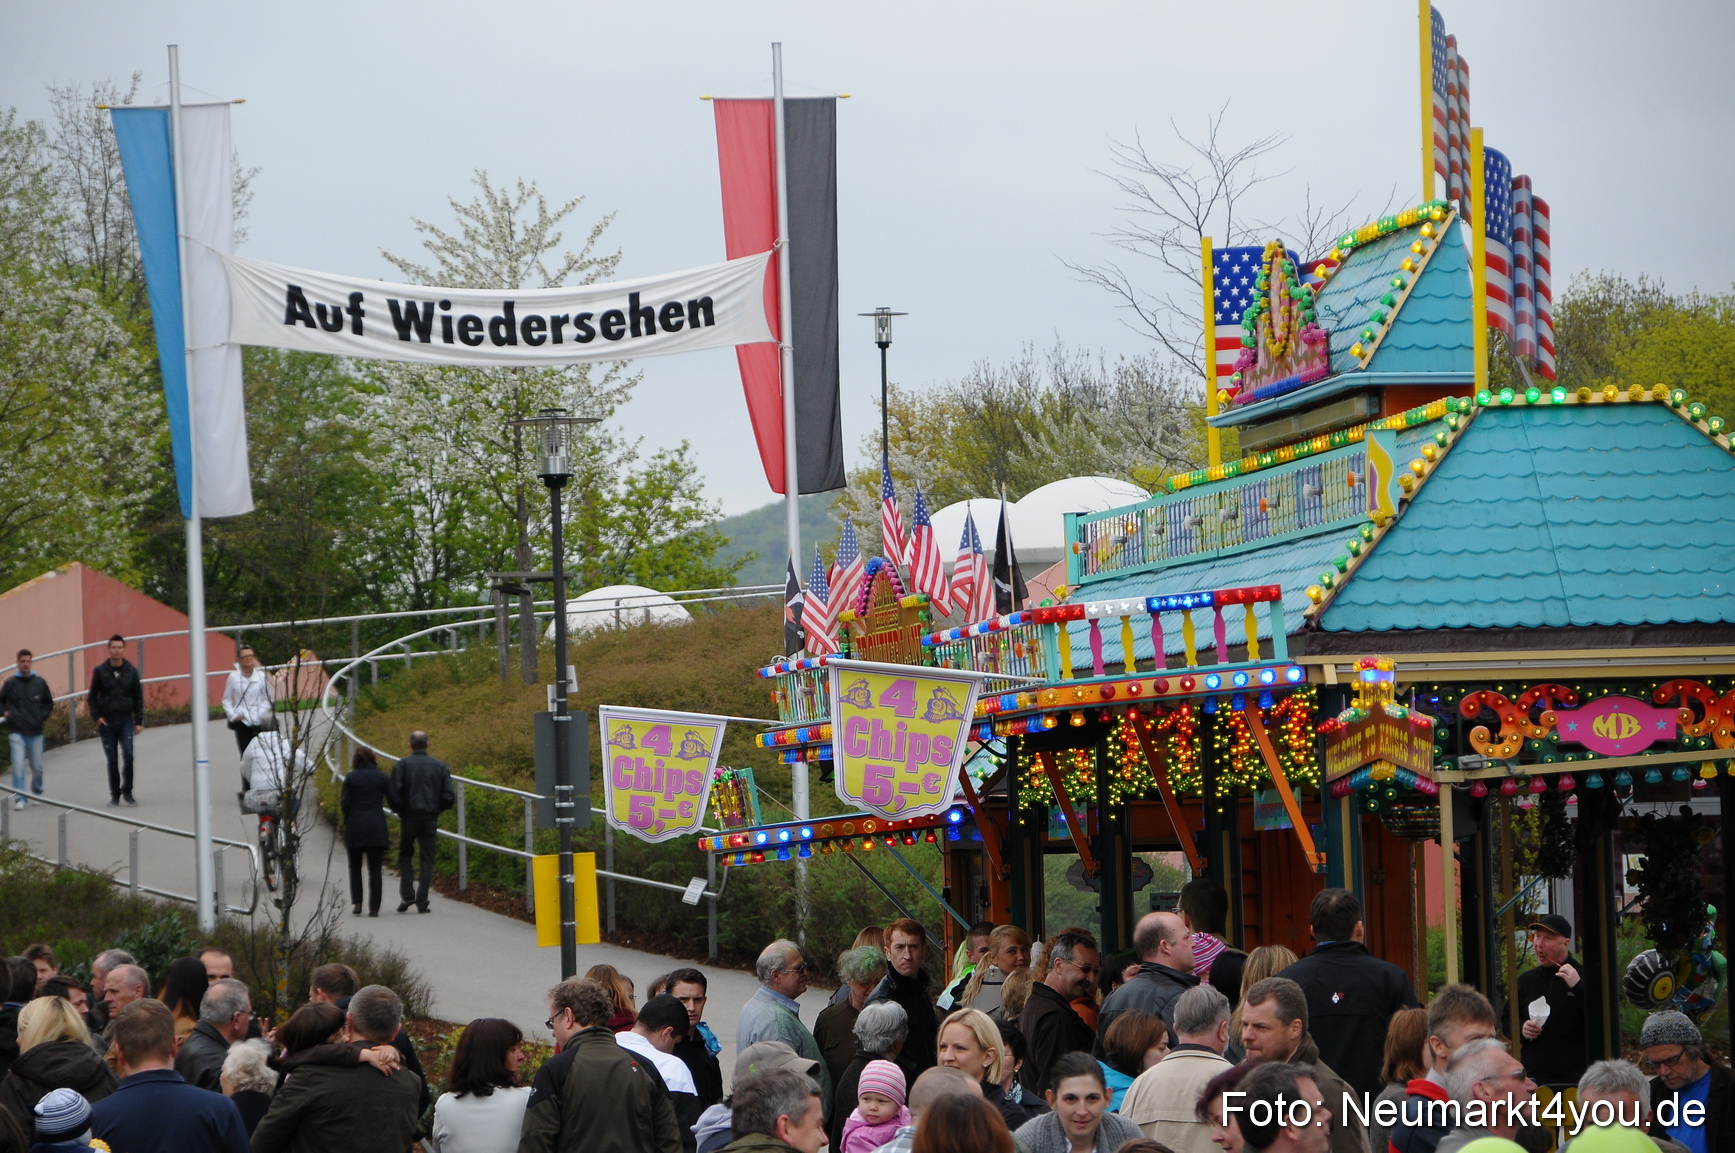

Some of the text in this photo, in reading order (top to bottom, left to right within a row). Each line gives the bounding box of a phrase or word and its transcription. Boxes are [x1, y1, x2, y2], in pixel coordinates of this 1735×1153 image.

[284, 284, 715, 347] Auf Wiedersehen
[878, 679, 917, 718] 4
[641, 725, 673, 757] 4
[844, 716, 953, 774] Chips
[1326, 722, 1432, 776] WELCOME TO KANSAS CITY
[1593, 713, 1642, 740] MB
[613, 755, 703, 802] Chips
